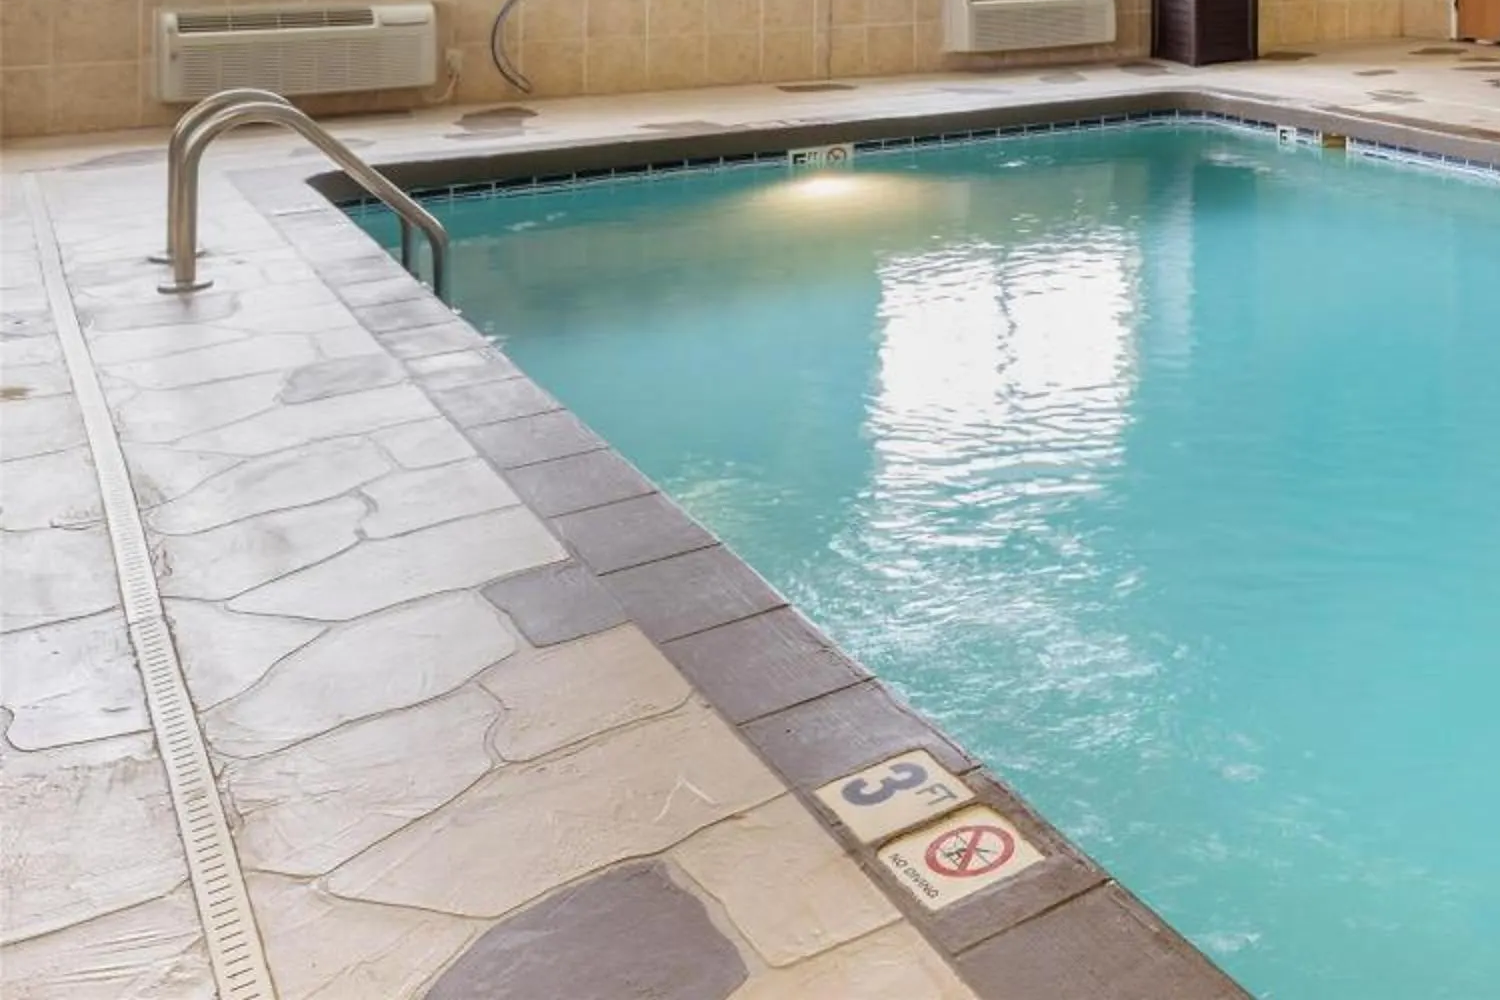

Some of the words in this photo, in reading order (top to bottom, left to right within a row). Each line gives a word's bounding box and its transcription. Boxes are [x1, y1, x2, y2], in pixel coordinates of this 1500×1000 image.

[841, 762, 929, 807] 3
[914, 782, 958, 806] FT
[888, 853, 909, 869] NO
